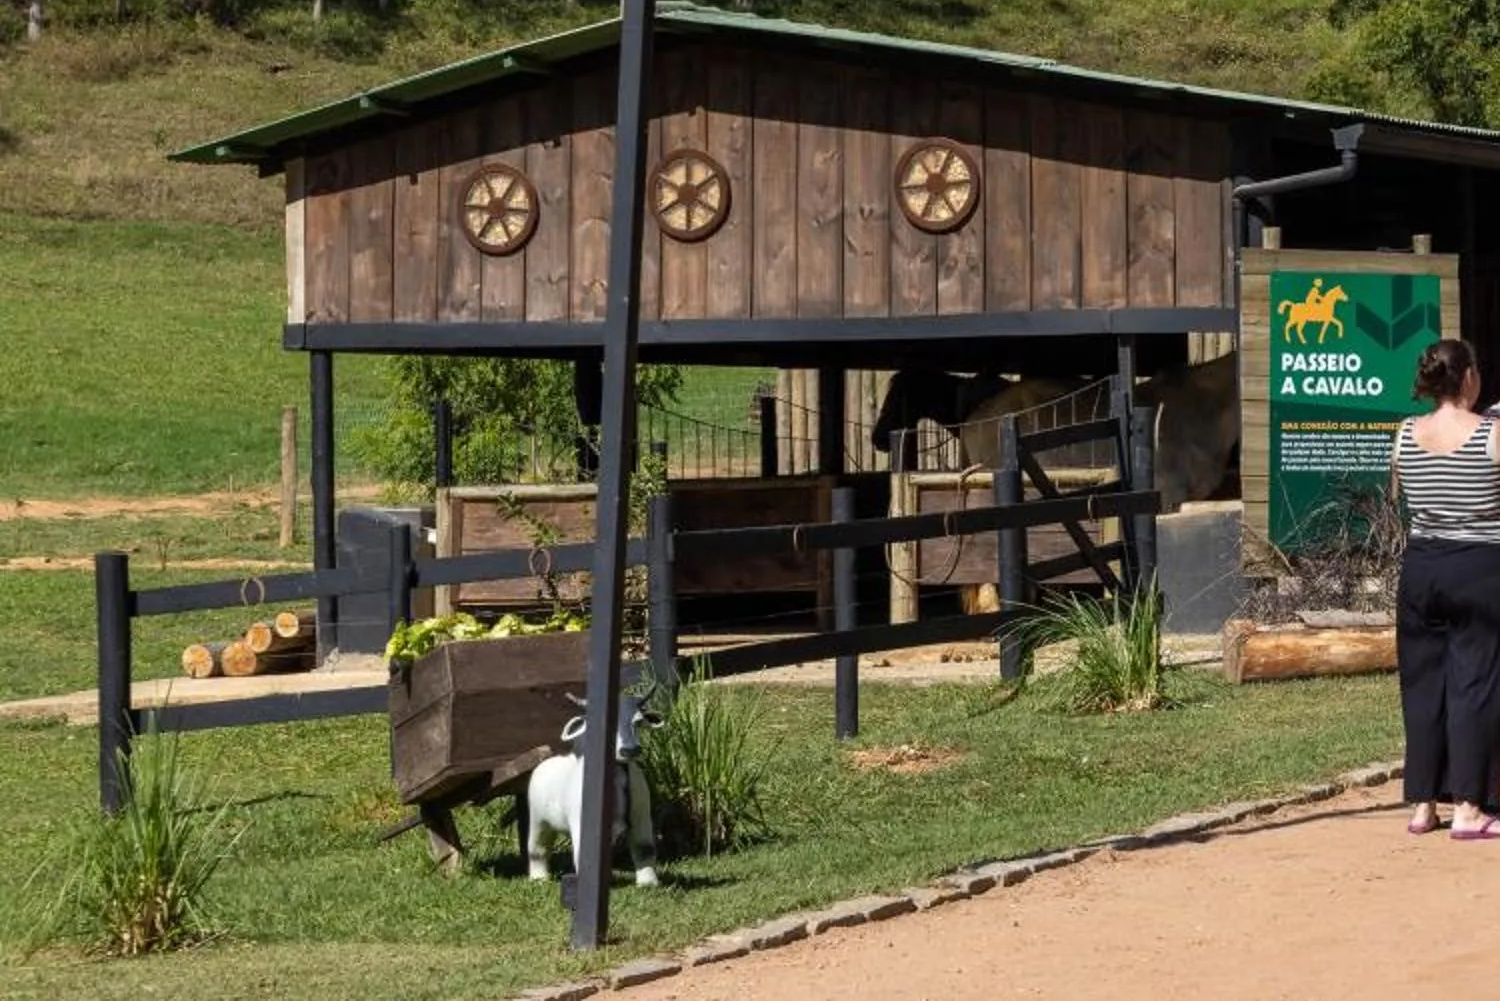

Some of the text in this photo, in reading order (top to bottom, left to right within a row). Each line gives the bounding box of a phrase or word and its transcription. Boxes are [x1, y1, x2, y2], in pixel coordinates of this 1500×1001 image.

[1281, 352, 1362, 372] PASSEIO
[1280, 375, 1384, 396] A CAVALO
